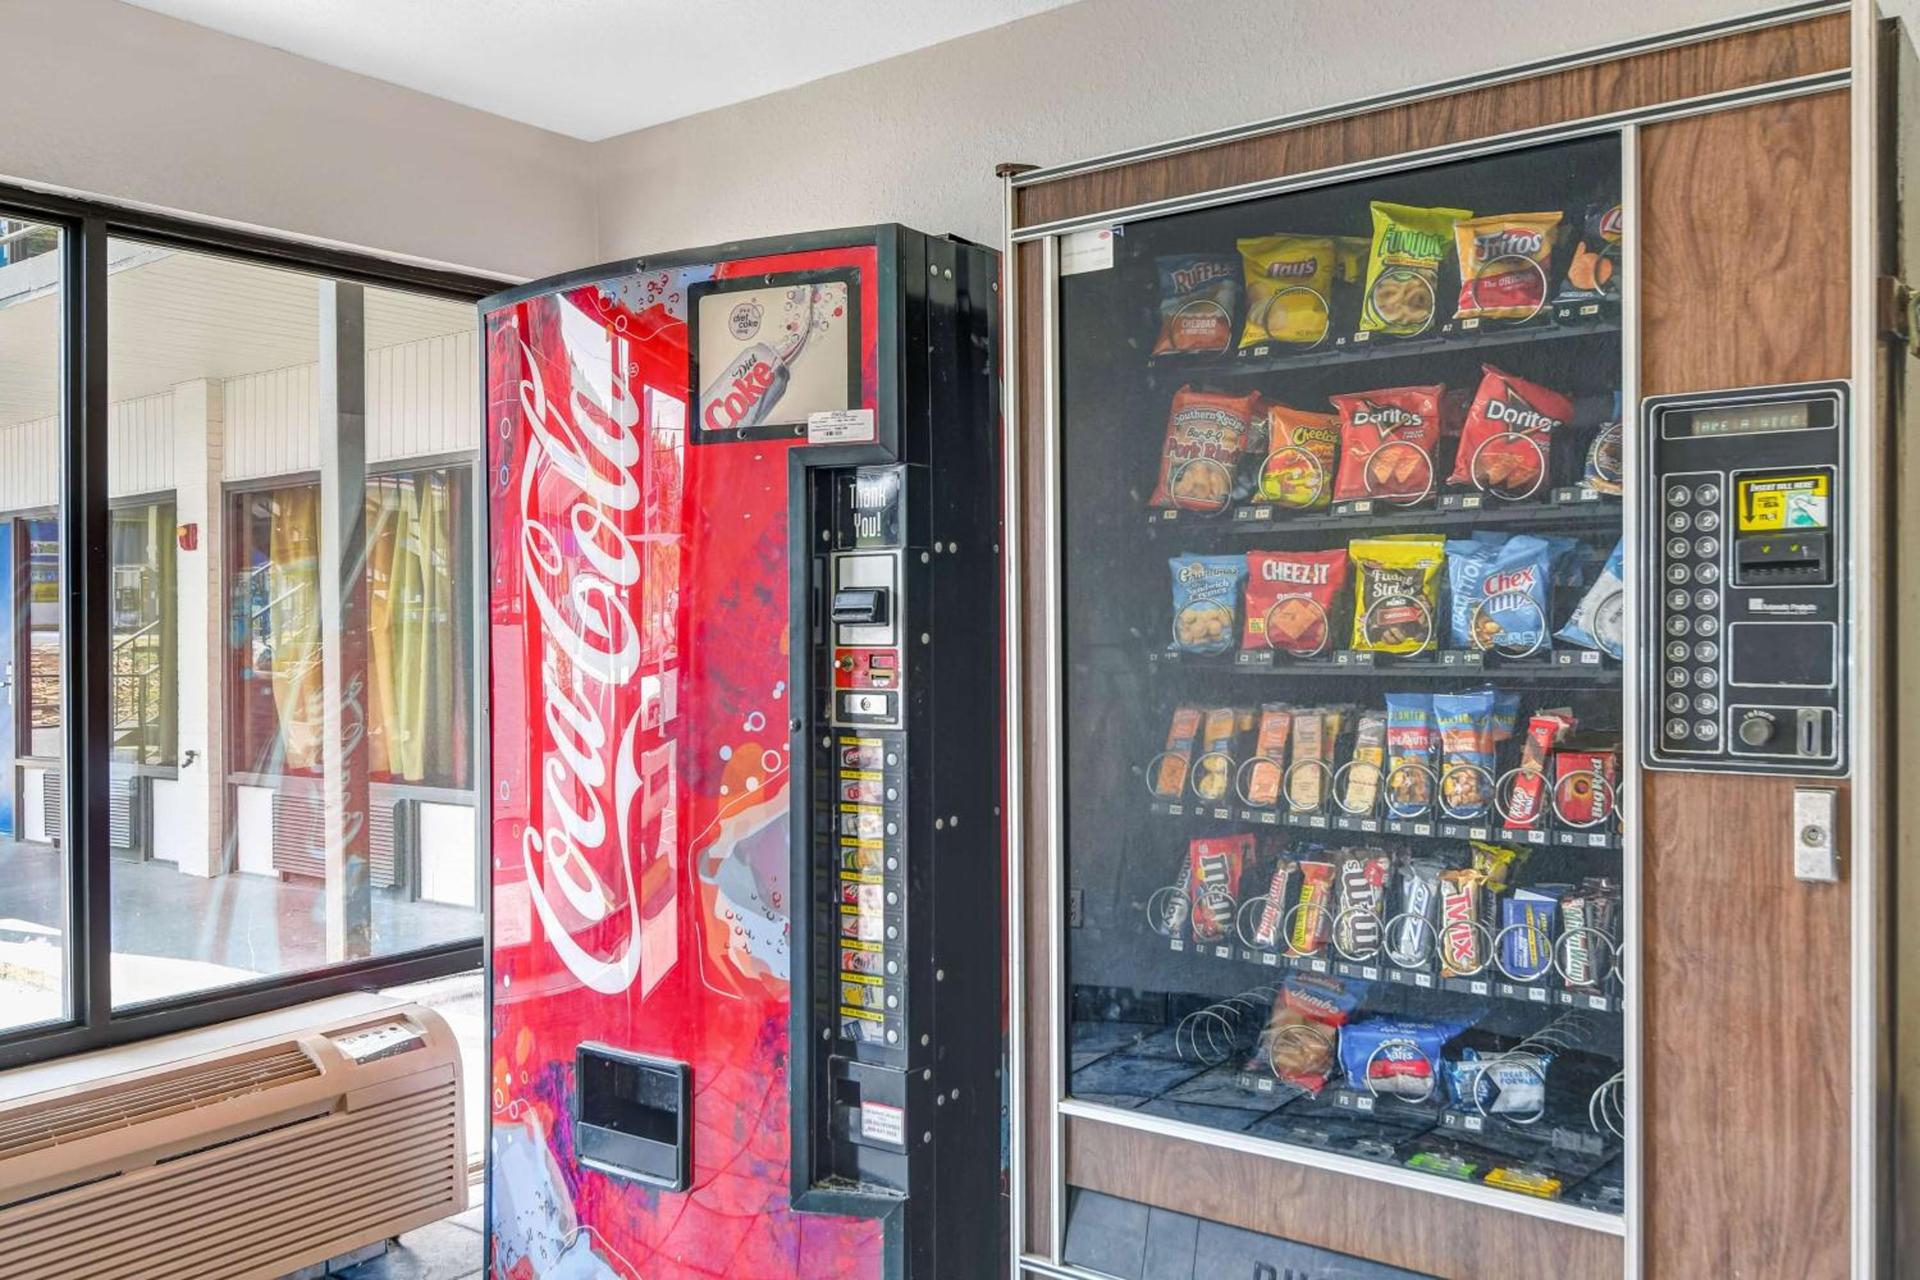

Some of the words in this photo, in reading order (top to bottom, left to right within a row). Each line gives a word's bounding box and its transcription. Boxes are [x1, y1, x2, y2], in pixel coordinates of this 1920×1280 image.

[1474, 233, 1542, 261] Fritos
[733, 313, 748, 322] diet
[1559, 309, 1570, 318] A9
[704, 361, 775, 430] Coke
[1354, 408, 1422, 426] Doritos
[1487, 400, 1562, 432] Doritos
[849, 484, 887, 509] Thank
[1675, 491, 1685, 501] A
[1704, 491, 1711, 500] 1
[854, 511, 881, 538] You!
[1675, 517, 1685, 527] B
[1704, 517, 1713, 527] 2
[1674, 543, 1686, 553] C
[1703, 543, 1712, 553] 3
[1674, 569, 1685, 579] D
[1703, 569, 1712, 578] 4
[1484, 566, 1534, 595] Chex
[1703, 595, 1712, 605] 5
[1703, 620, 1712, 630] 6
[1703, 646, 1711, 656] 7
[1338, 655, 1348, 663] C5
[1560, 656, 1571, 664] C9
[519, 337, 645, 996] Coca-Cola
[1674, 672, 1685, 682] H
[1703, 673, 1712, 683] 8
[1674, 698, 1683, 708] J
[1743, 709, 1776, 721] return
[1674, 724, 1684, 734] K
[1700, 725, 1713, 735] 10
[1591, 787, 1602, 818] Big
[1445, 826, 1456, 835] D7
[1561, 833, 1573, 843] D9
[1443, 887, 1474, 963] TWIX
[1291, 989, 1339, 1014] Jumbo
[1446, 1115, 1455, 1124] F7
